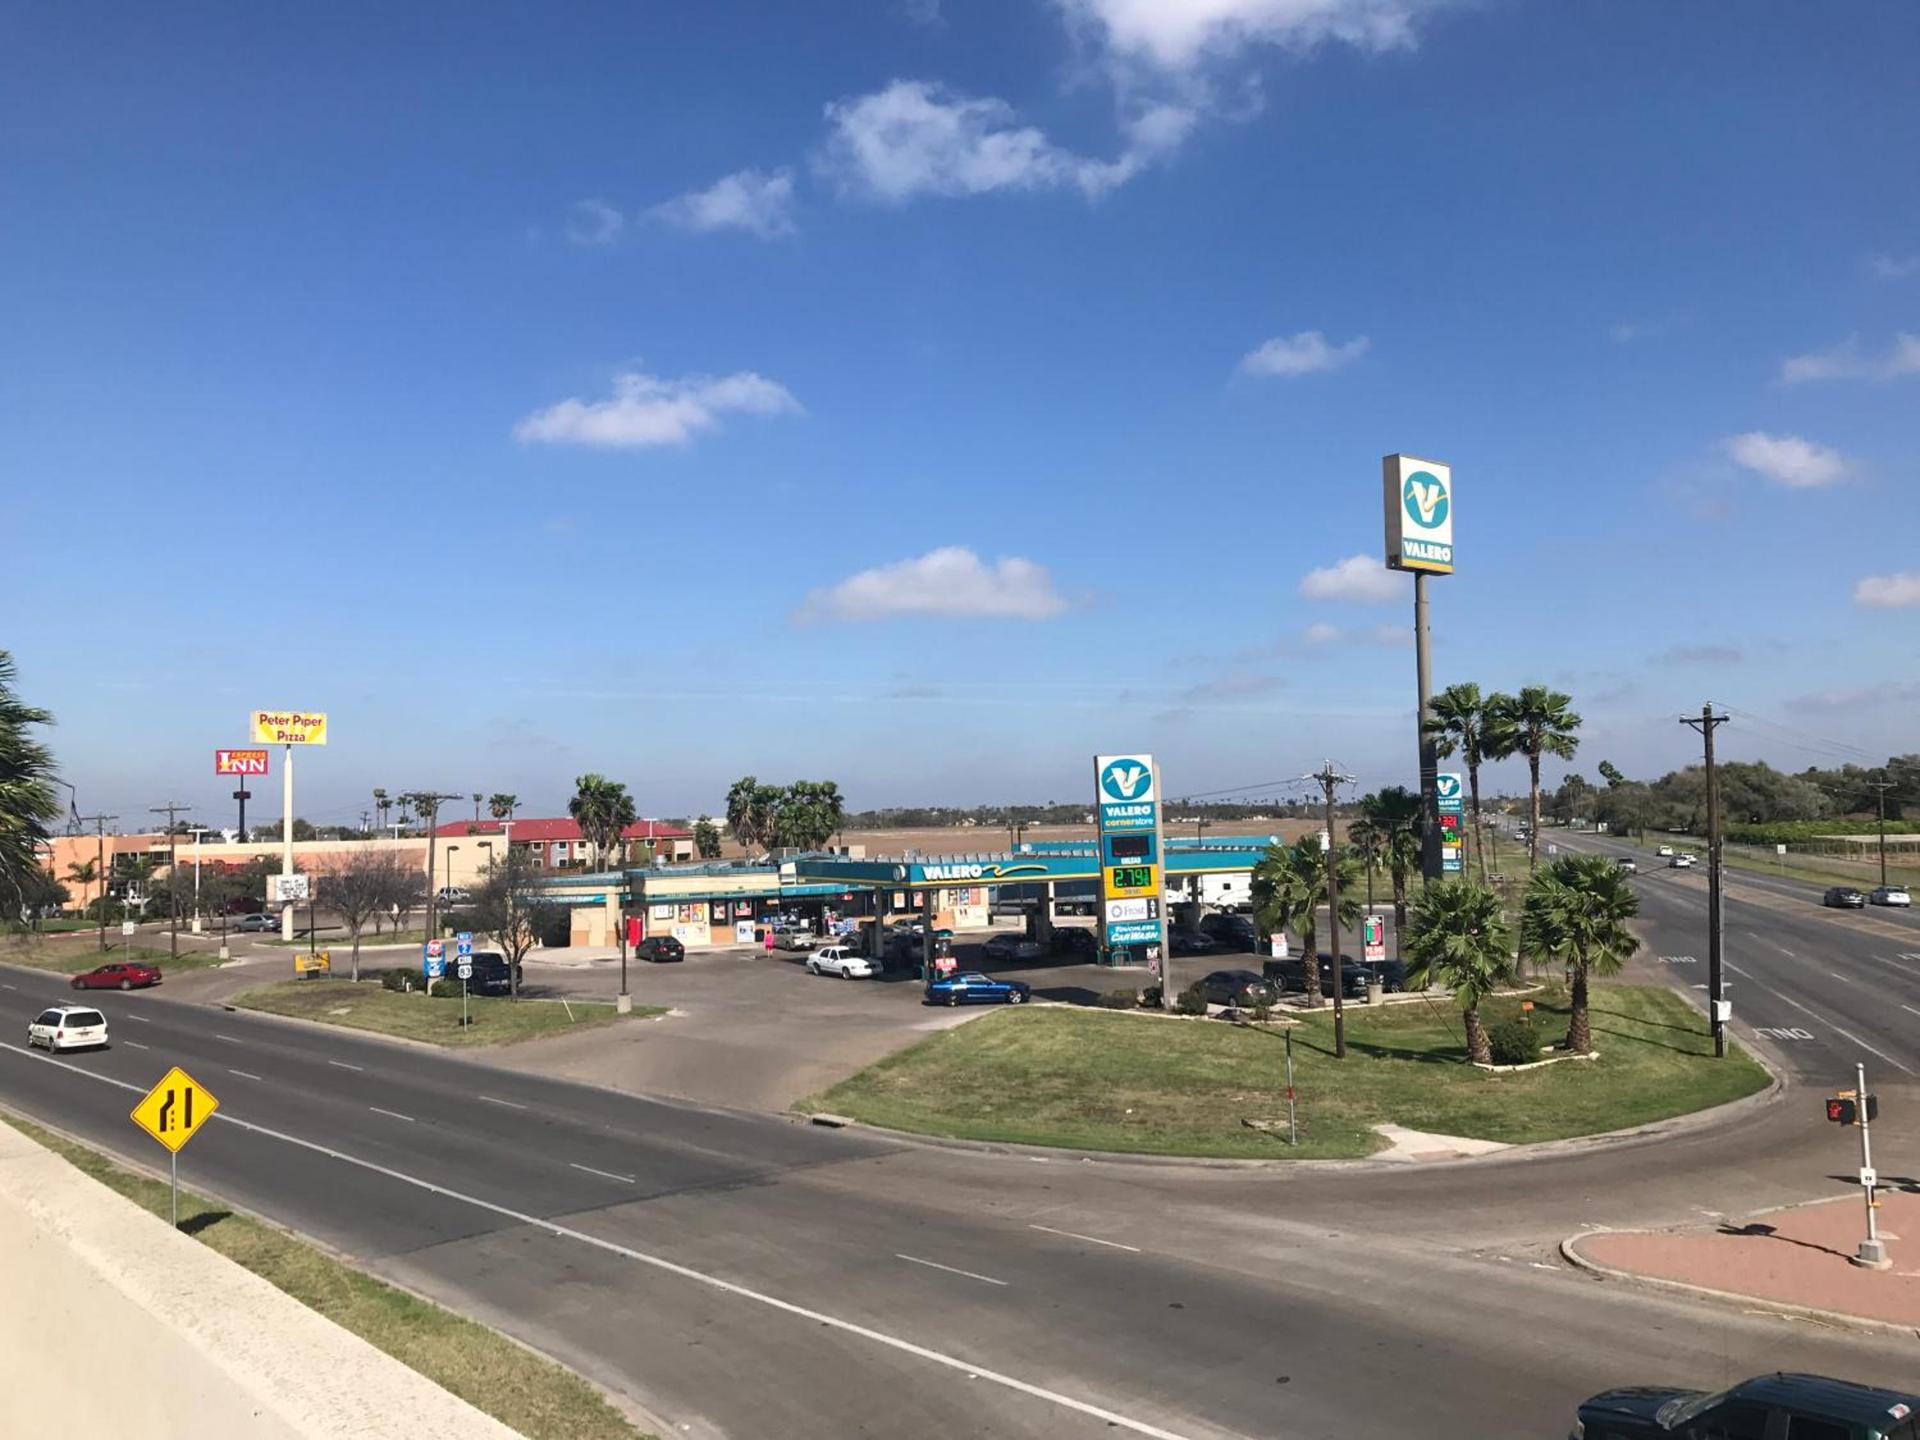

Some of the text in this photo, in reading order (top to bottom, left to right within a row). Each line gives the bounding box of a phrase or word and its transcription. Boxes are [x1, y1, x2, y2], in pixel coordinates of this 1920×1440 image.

[1403, 541, 1452, 562] VALERO
[259, 714, 322, 728] Peter Piper
[277, 730, 306, 742] Pizza
[1105, 805, 1152, 817] VALERO
[923, 864, 983, 880] VALERO
[1124, 905, 1145, 916] Frost
[1656, 955, 1697, 964] ONLY
[460, 966, 471, 977] 83
[1752, 1027, 1815, 1041] ONLY
